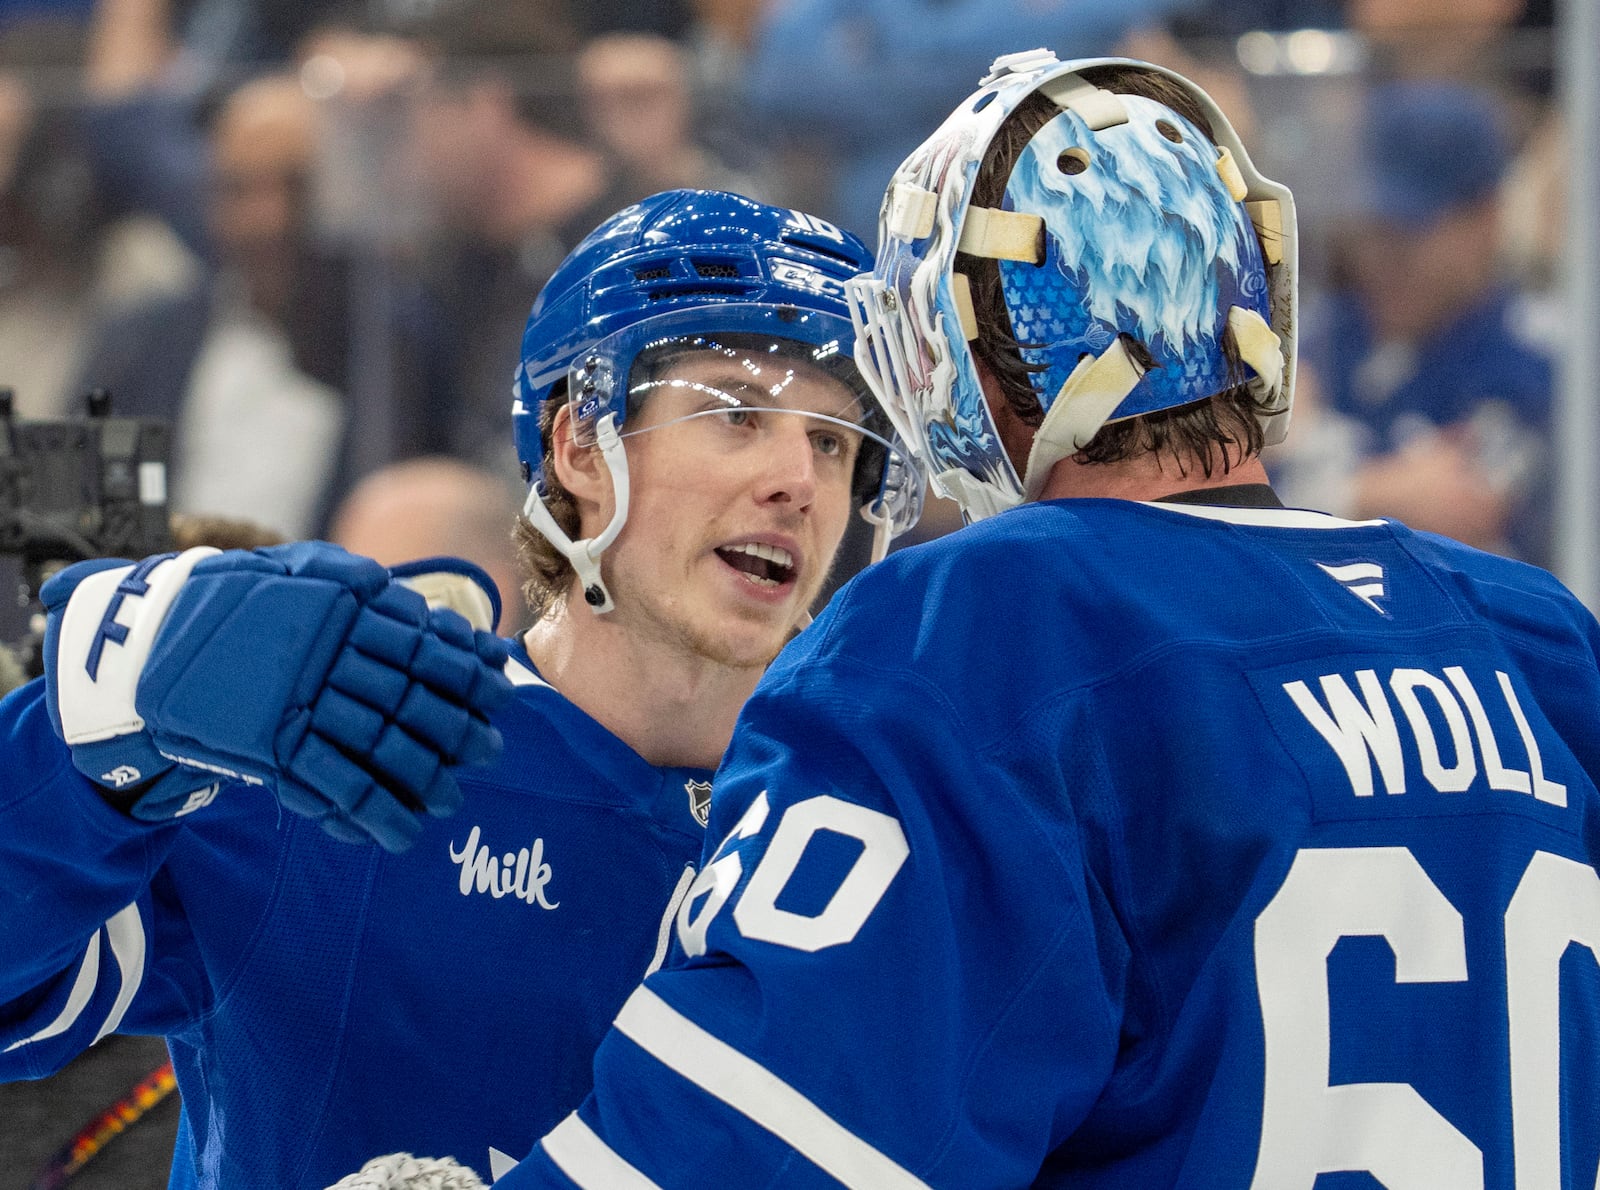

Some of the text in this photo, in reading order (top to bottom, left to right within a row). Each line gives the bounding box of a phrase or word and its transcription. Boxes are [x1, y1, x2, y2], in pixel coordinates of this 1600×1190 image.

[773, 262, 849, 298] CC
[1282, 666, 1568, 808] WOLL
[449, 825, 560, 910] Milk
[676, 790, 911, 959] 60
